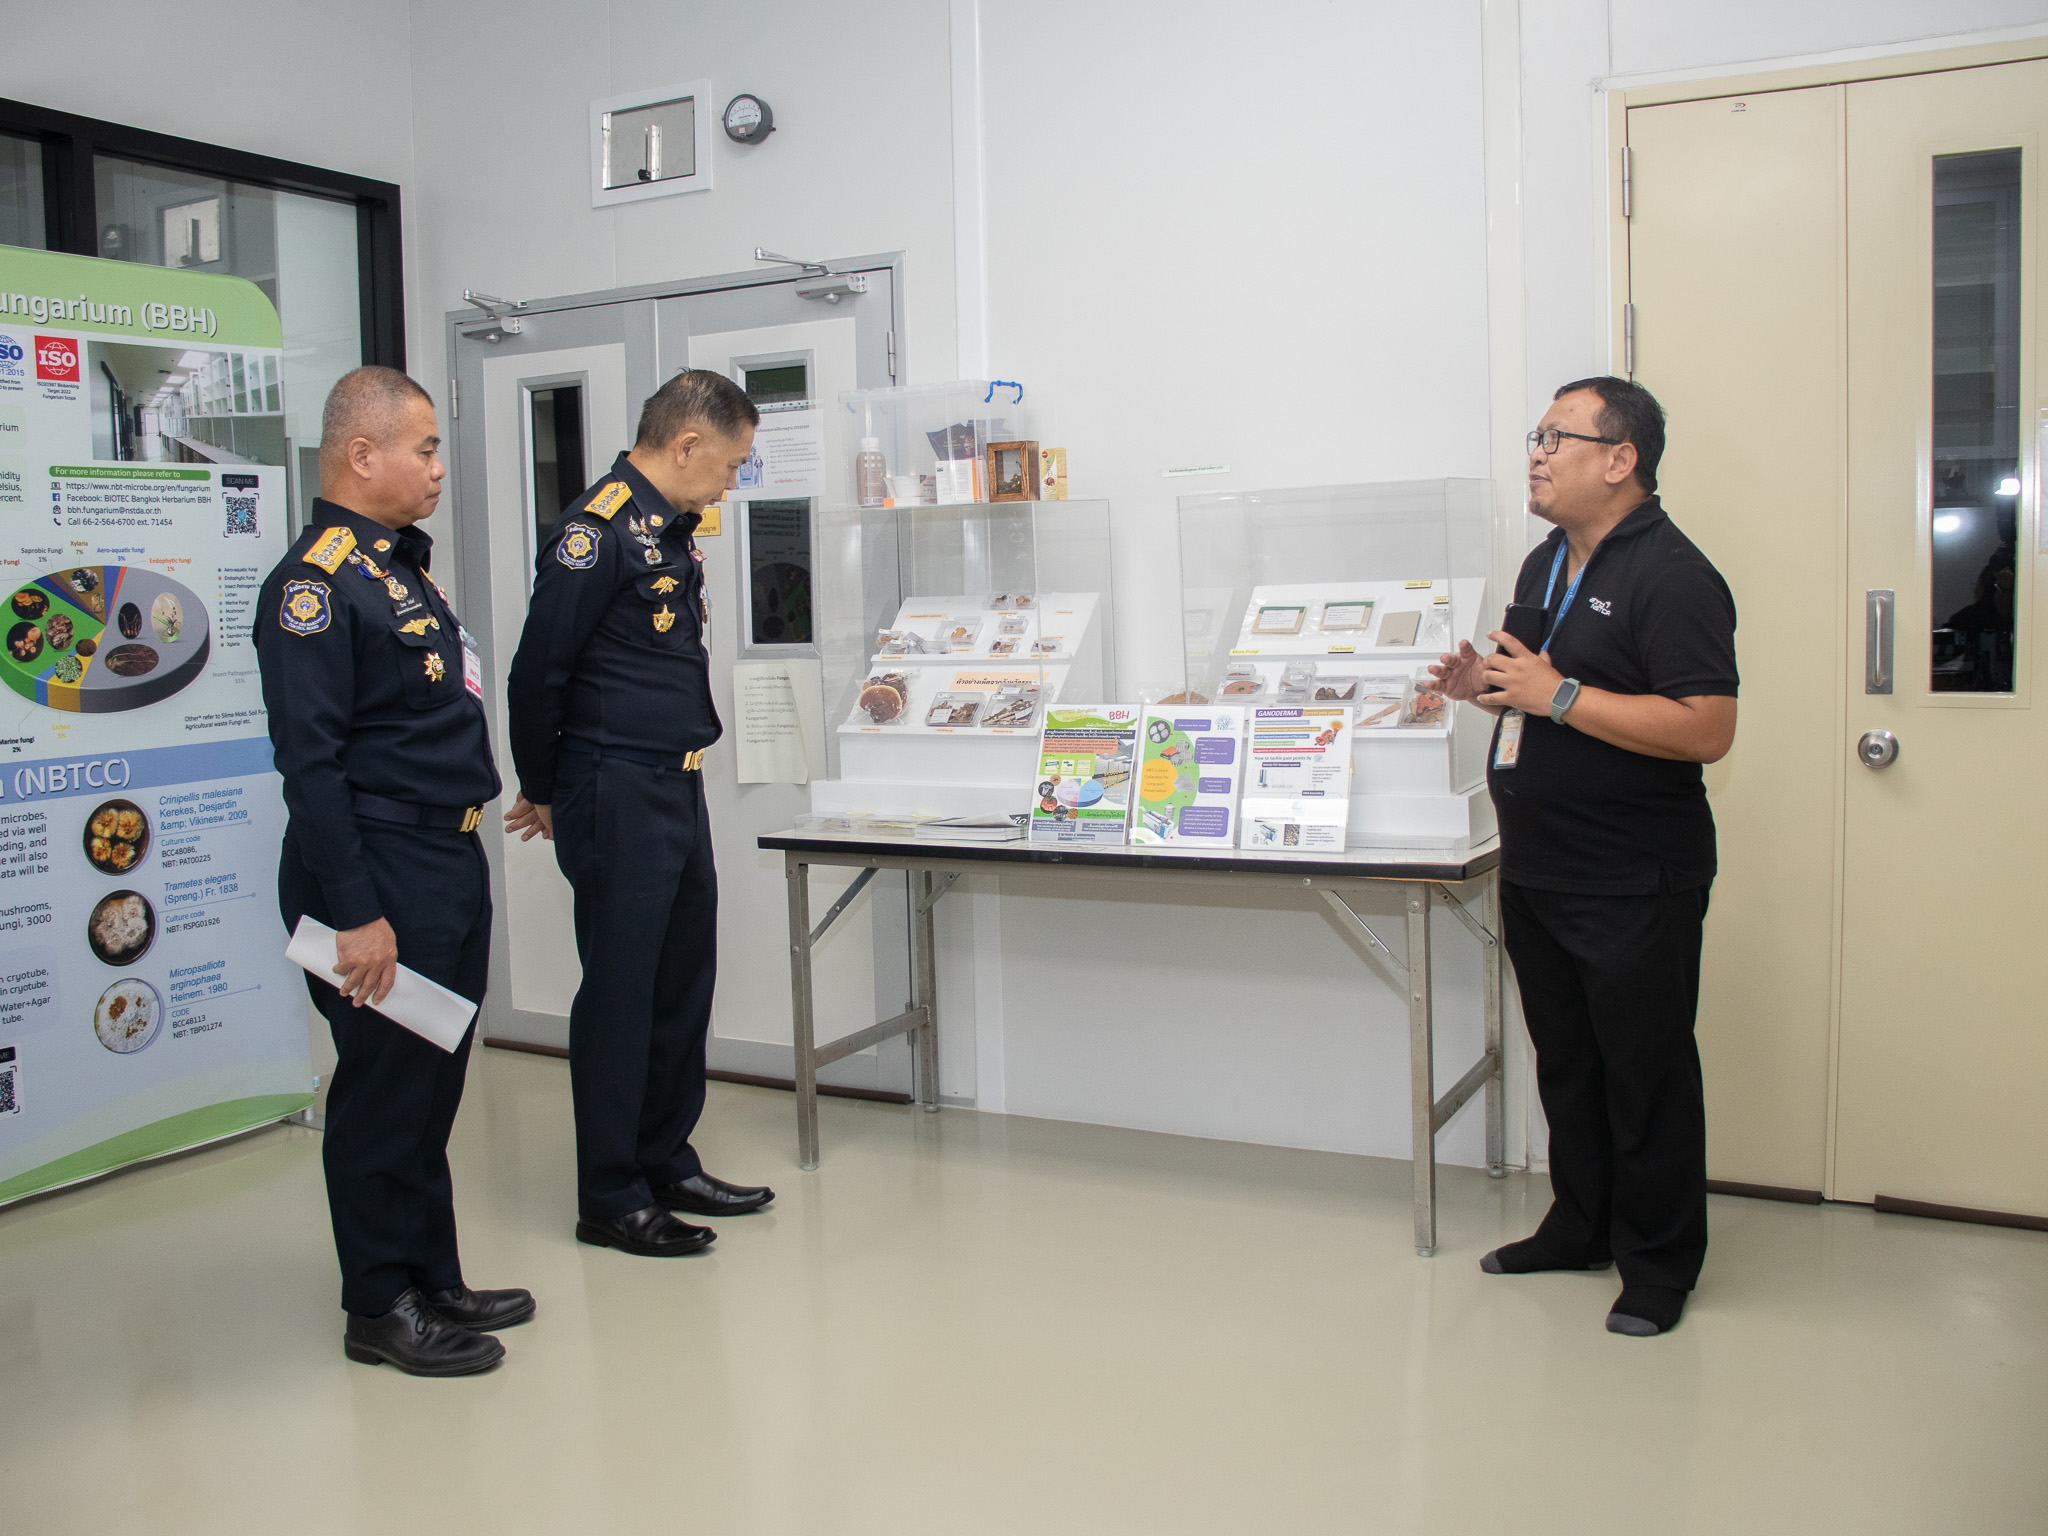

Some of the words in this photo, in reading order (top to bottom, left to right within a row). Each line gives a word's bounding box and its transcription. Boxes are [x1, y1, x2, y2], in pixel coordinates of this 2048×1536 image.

[141, 302, 217, 337] (BBH)
[39, 350, 76, 367] ISO
[90, 468, 131, 477] information
[132, 470, 154, 478] please
[66, 482, 211, 493] https://www.nbt-microbe.org/en/fungarium
[245, 478, 255, 486] ME
[66, 494, 103, 503] Facebook:
[104, 495, 130, 503] BIOTEC
[132, 495, 161, 505] Bangkok
[162, 496, 196, 504] Herbarium
[198, 496, 212, 504] BBH
[67, 506, 162, 516] bbh.fungarium@nstda.or.th
[68, 518, 81, 526] Call
[82, 518, 136, 527] 66-2-564-6700
[152, 518, 173, 526] 71454
[70, 540, 89, 548] Xylaria
[132, 546, 146, 554] fungi
[4, 559, 20, 567] Fungi
[1108, 710, 1130, 720] BBH
[184, 722, 214, 730] Agricultural
[228, 718, 242, 726] Fungi
[20, 736, 35, 744] fungi
[14, 758, 131, 800] (NBTCC)
[159, 792, 200, 806] Crinipellis
[202, 787, 243, 800] malesiana
[160, 807, 197, 818] Kerekes,
[198, 800, 237, 813] Desjardin
[1, 812, 48, 824] microbes,
[160, 820, 187, 831] &amp;
[188, 814, 226, 827] Vikinesw.
[228, 810, 248, 821] 2009
[12, 827, 26, 836] via
[28, 824, 47, 834] well
[29, 838, 48, 848] and
[161, 837, 184, 847] Culture
[186, 834, 201, 844] code
[10, 854, 26, 864] will
[28, 851, 48, 861] also
[19, 866, 35, 876] will
[38, 864, 49, 874] be
[162, 860, 178, 869] NBT:
[164, 877, 203, 892] Trametes
[204, 872, 237, 886] elegans
[164, 888, 204, 906] (Spreng.)
[205, 887, 217, 897] Fr.
[219, 883, 239, 895] 1838
[26, 914, 52, 926] 3000
[166, 912, 189, 924] Culture
[190, 910, 206, 919] code
[166, 925, 182, 934] NBT:
[183, 917, 221, 931] RSPG01926
[6, 968, 50, 983] cryotube,
[170, 960, 226, 980] Micropsalliota
[10, 980, 49, 996] cryotube.
[170, 972, 222, 992] arginophaea
[170, 990, 206, 1003] Heinem.
[208, 982, 228, 995] 1980
[0, 996, 52, 1013] Water+Agar
[172, 1008, 190, 1018] CODE
[2, 1014, 25, 1025] tube.
[172, 1014, 206, 1029] BCC48113
[173, 1030, 189, 1040] NBT:
[190, 1021, 223, 1035] TBP01274
